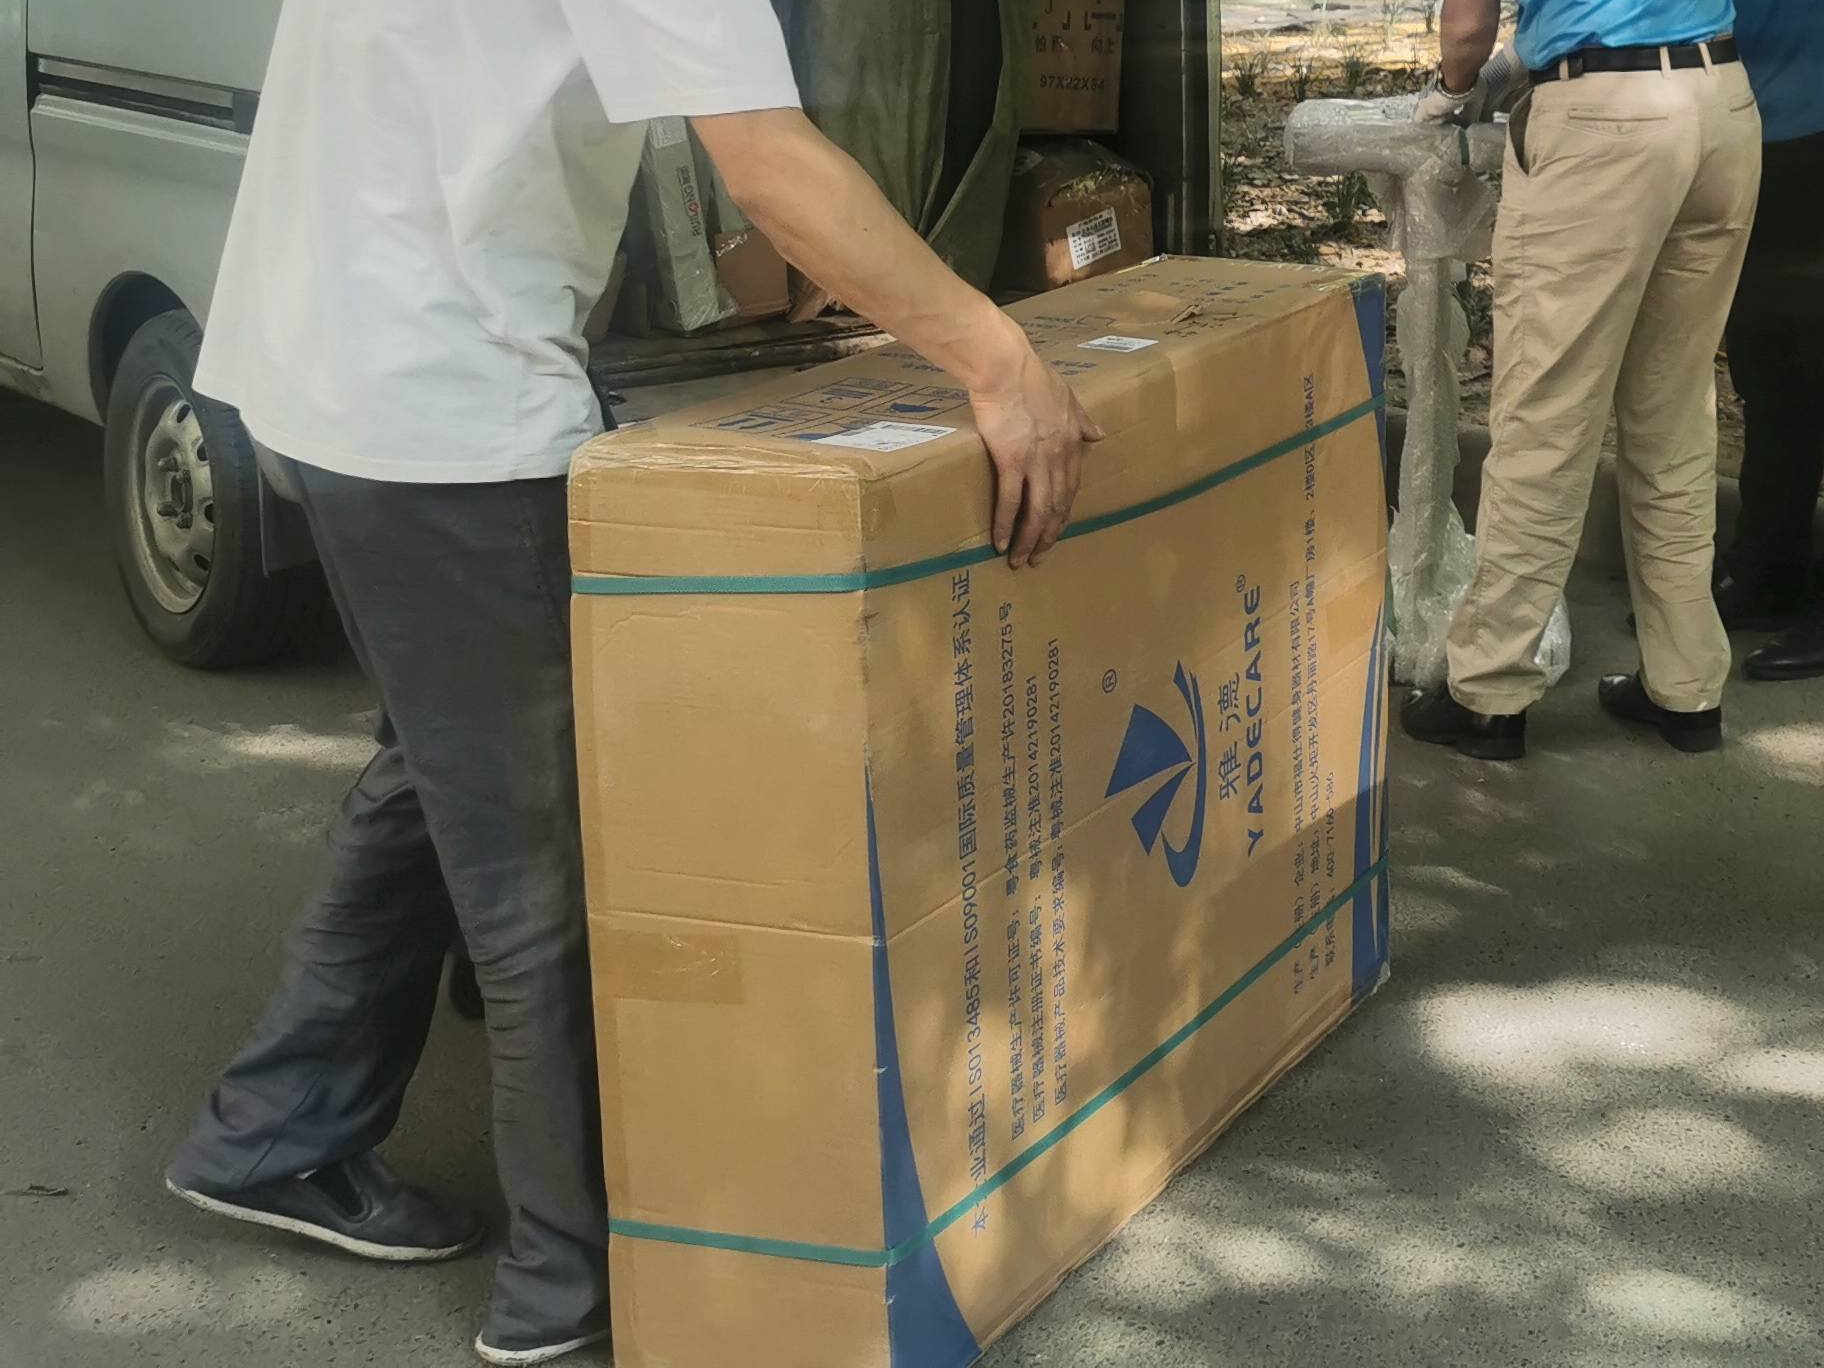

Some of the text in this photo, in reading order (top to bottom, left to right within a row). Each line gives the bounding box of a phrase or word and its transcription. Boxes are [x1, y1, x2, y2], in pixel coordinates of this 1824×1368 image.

[1218, 673, 1242, 801] 雅德
[1241, 586, 1264, 857] YADECARE
[951, 569, 988, 1236] 本业通过ISO13485和ISO9001国际质量管理体系认证
